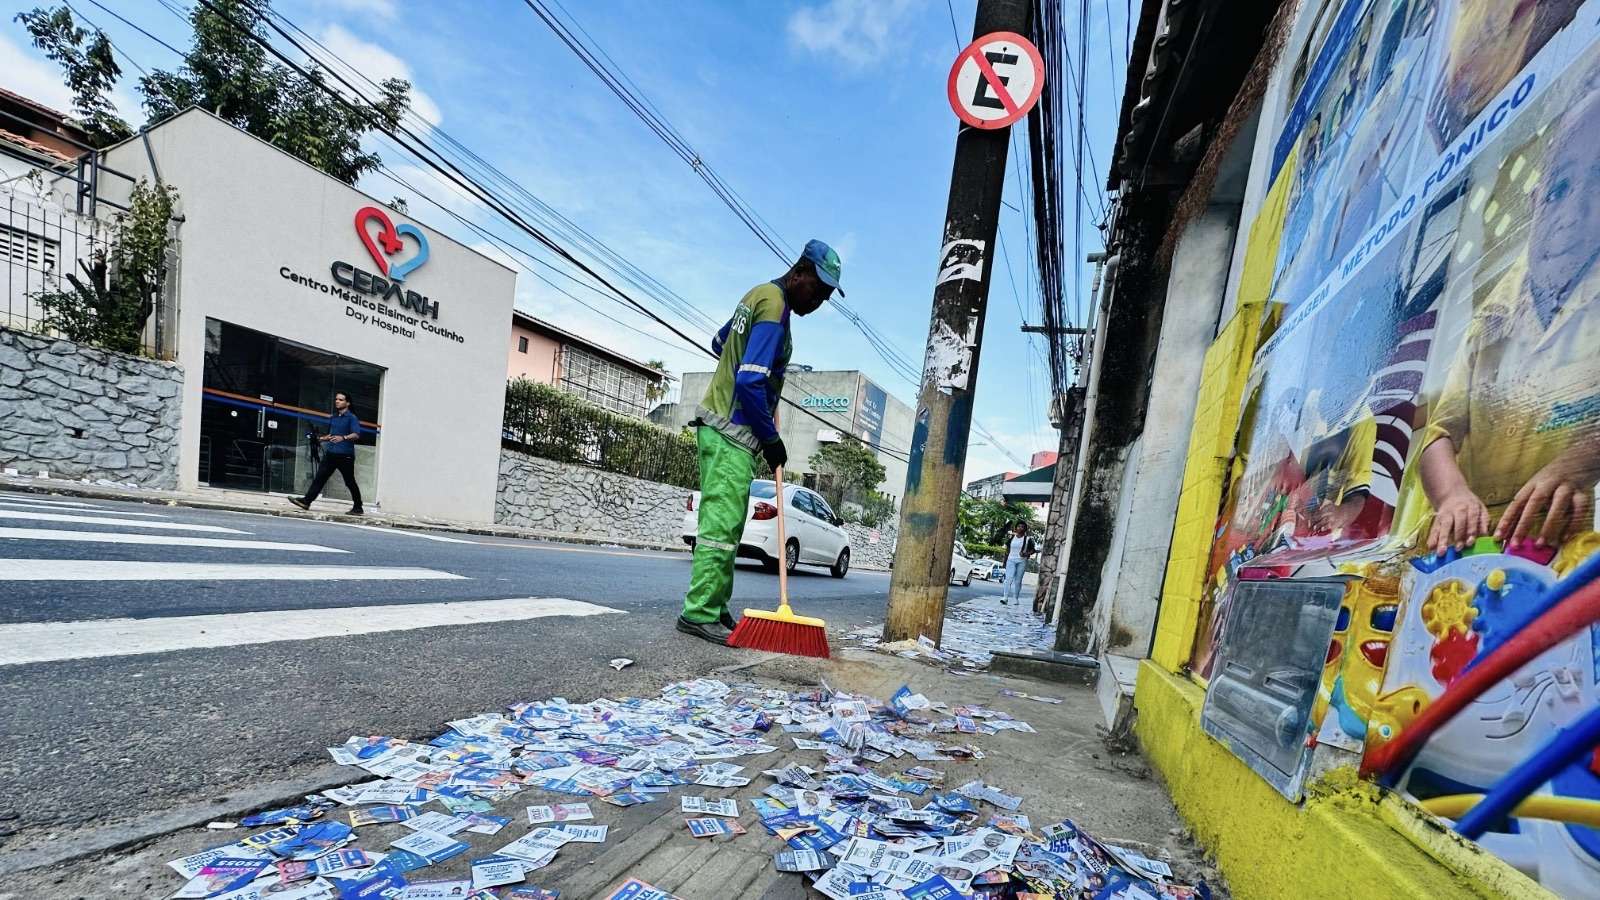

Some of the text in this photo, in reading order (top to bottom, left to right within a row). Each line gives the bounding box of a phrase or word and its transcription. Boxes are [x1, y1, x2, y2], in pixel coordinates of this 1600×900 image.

[972, 52, 1019, 110] E
[279, 266, 465, 343] Centro Médico Elsimar Coutinho
[331, 261, 440, 320] CEPARH
[345, 305, 416, 339] Day Hospital
